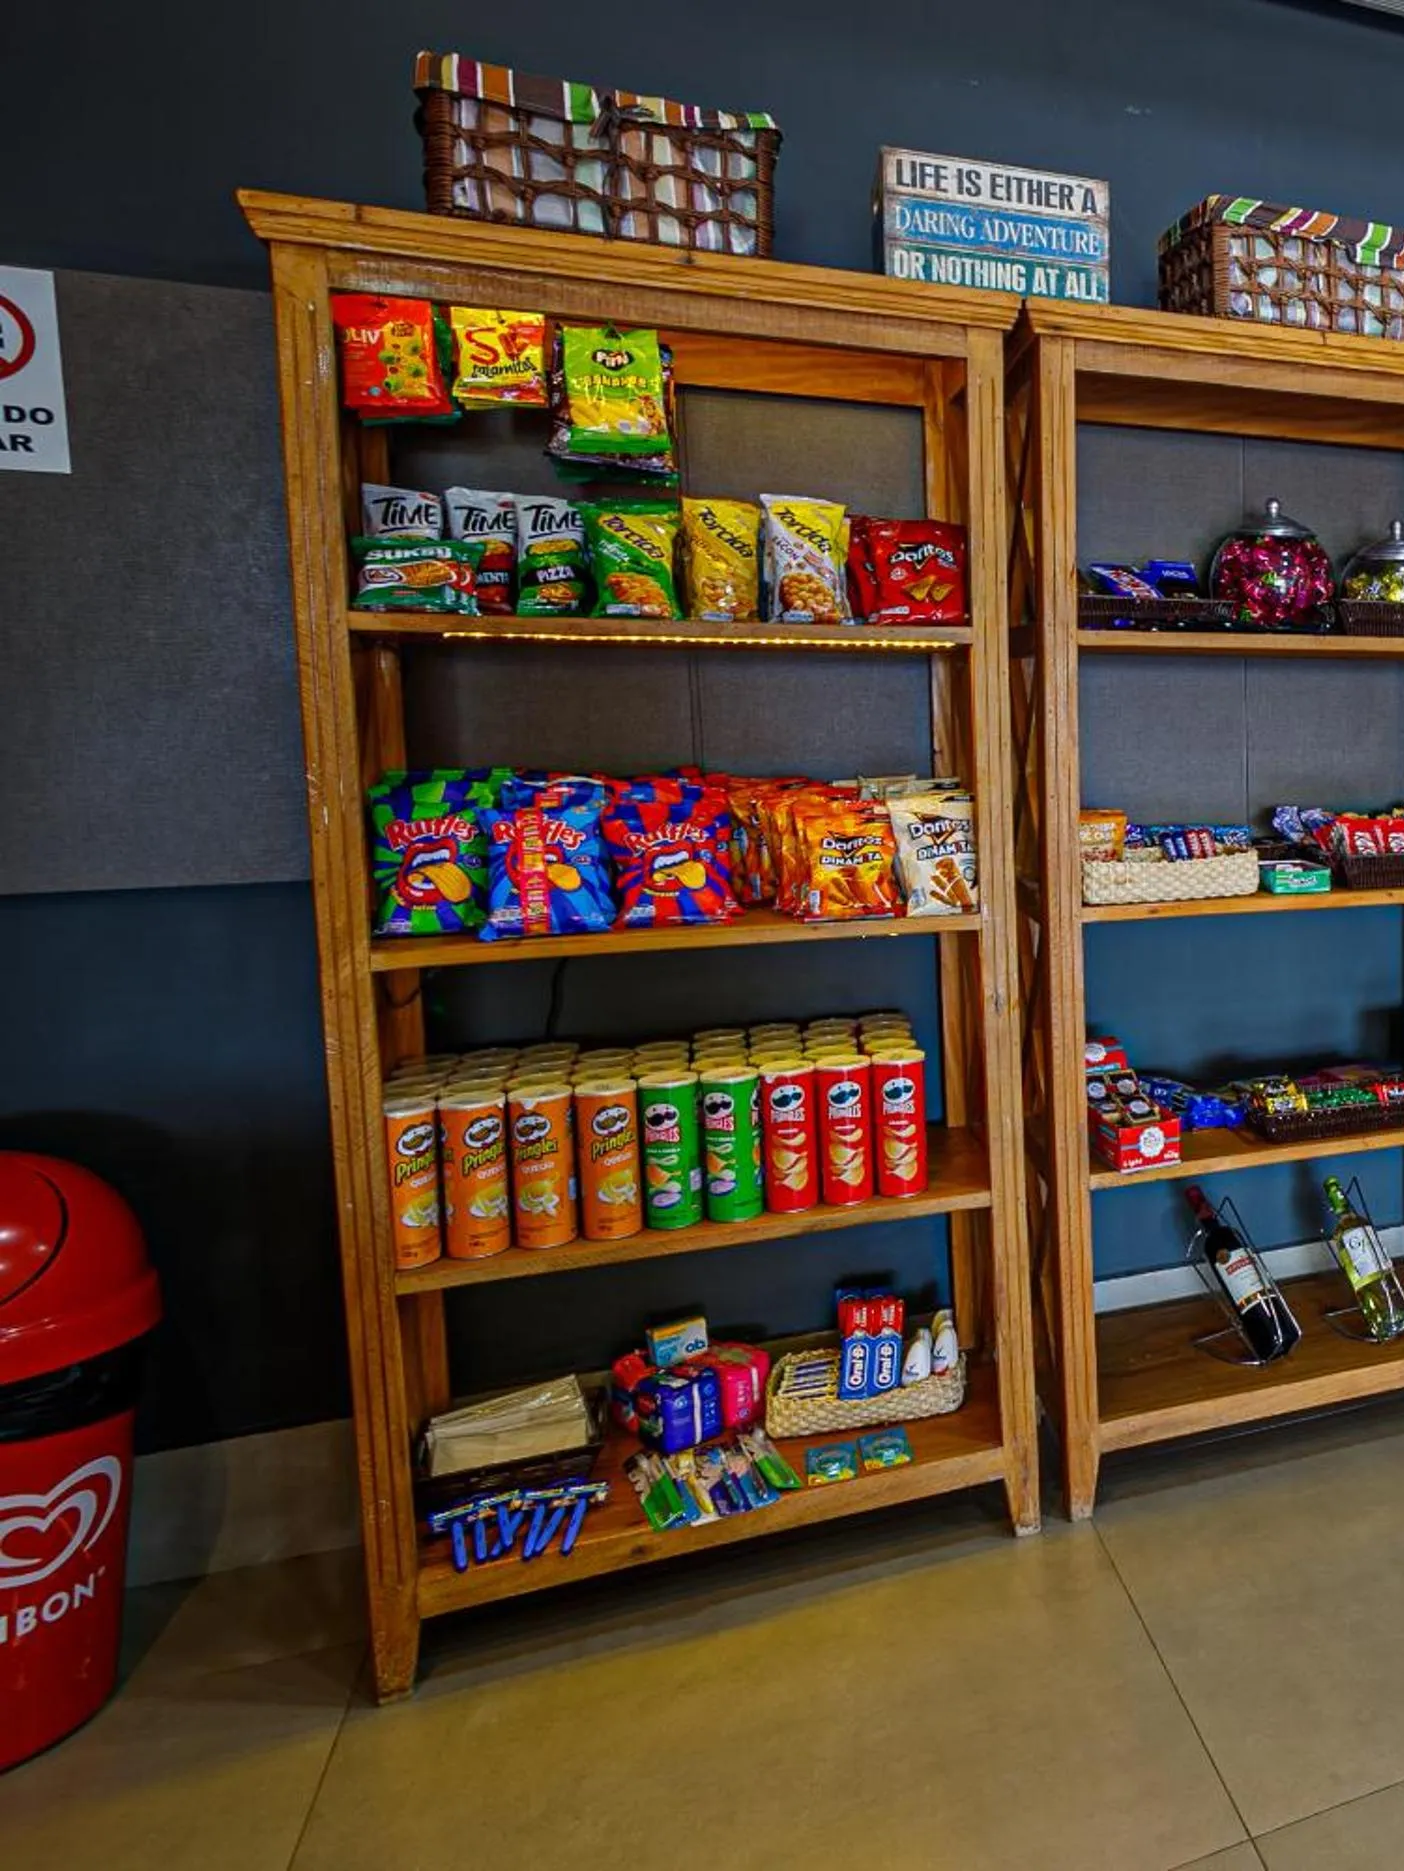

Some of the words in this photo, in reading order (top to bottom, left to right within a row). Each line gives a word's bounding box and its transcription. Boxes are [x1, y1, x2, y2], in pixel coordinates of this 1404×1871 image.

[896, 159, 949, 194] LIFE
[956, 168, 982, 197] IS
[990, 173, 1074, 211] EITHER
[1082, 188, 1098, 214] A
[895, 205, 976, 239] DARING
[981, 218, 1101, 255] ADVENTURE
[893, 250, 925, 280] OR
[931, 253, 1027, 293] NOTHING
[1032, 268, 1060, 296] AT
